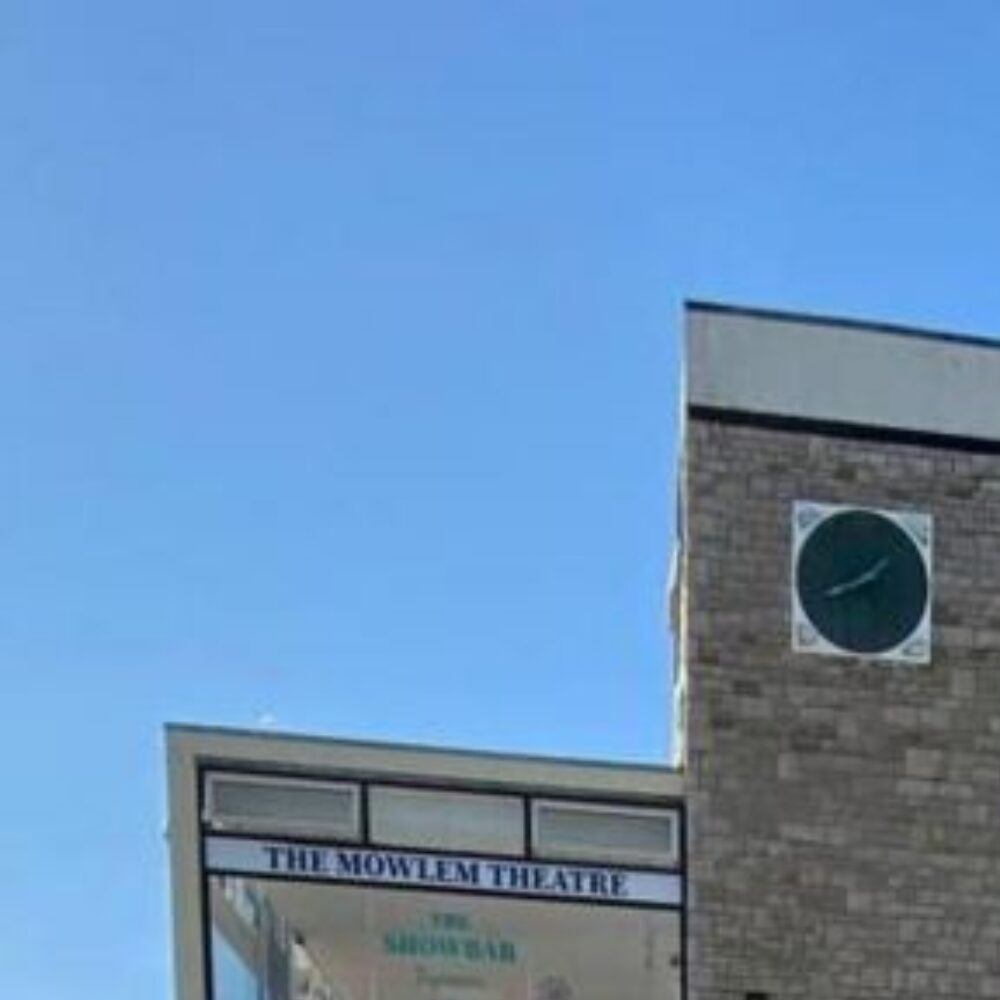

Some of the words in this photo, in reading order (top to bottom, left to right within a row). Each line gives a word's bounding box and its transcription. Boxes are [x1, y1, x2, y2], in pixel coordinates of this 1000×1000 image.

[264, 846, 329, 872] THE
[336, 851, 479, 886] MOWLEM
[488, 864, 629, 897] THEATRE
